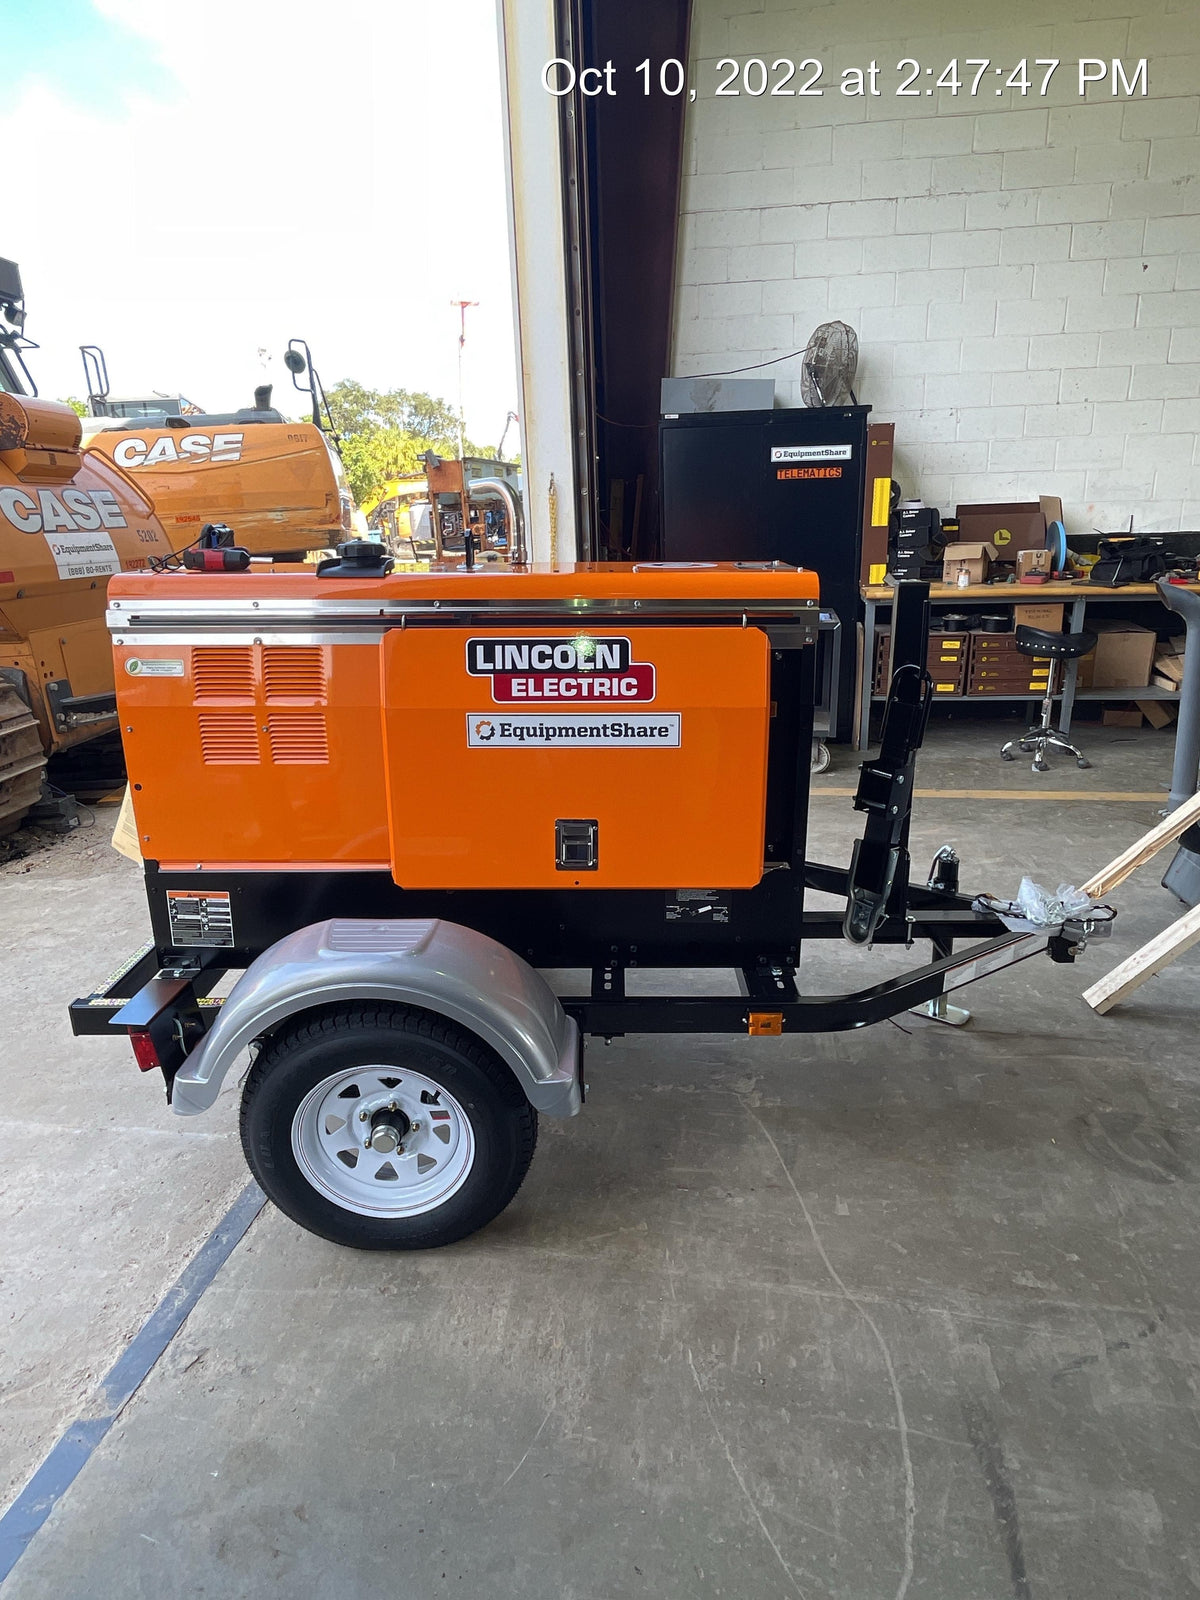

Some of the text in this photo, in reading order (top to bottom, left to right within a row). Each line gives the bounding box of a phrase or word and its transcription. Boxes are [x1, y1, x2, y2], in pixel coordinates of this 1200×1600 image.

[113, 433, 244, 468] CASE
[783, 449, 847, 458] EquipmentShare
[778, 468, 841, 479] TELEMATICS
[0, 487, 128, 534] CASE
[136, 530, 159, 542] 5202
[60, 544, 113, 554] EquipmentShare
[476, 645, 620, 670] LINCOLN
[511, 678, 638, 697] ELECTRIC
[499, 722, 669, 741] EquipmentShare
